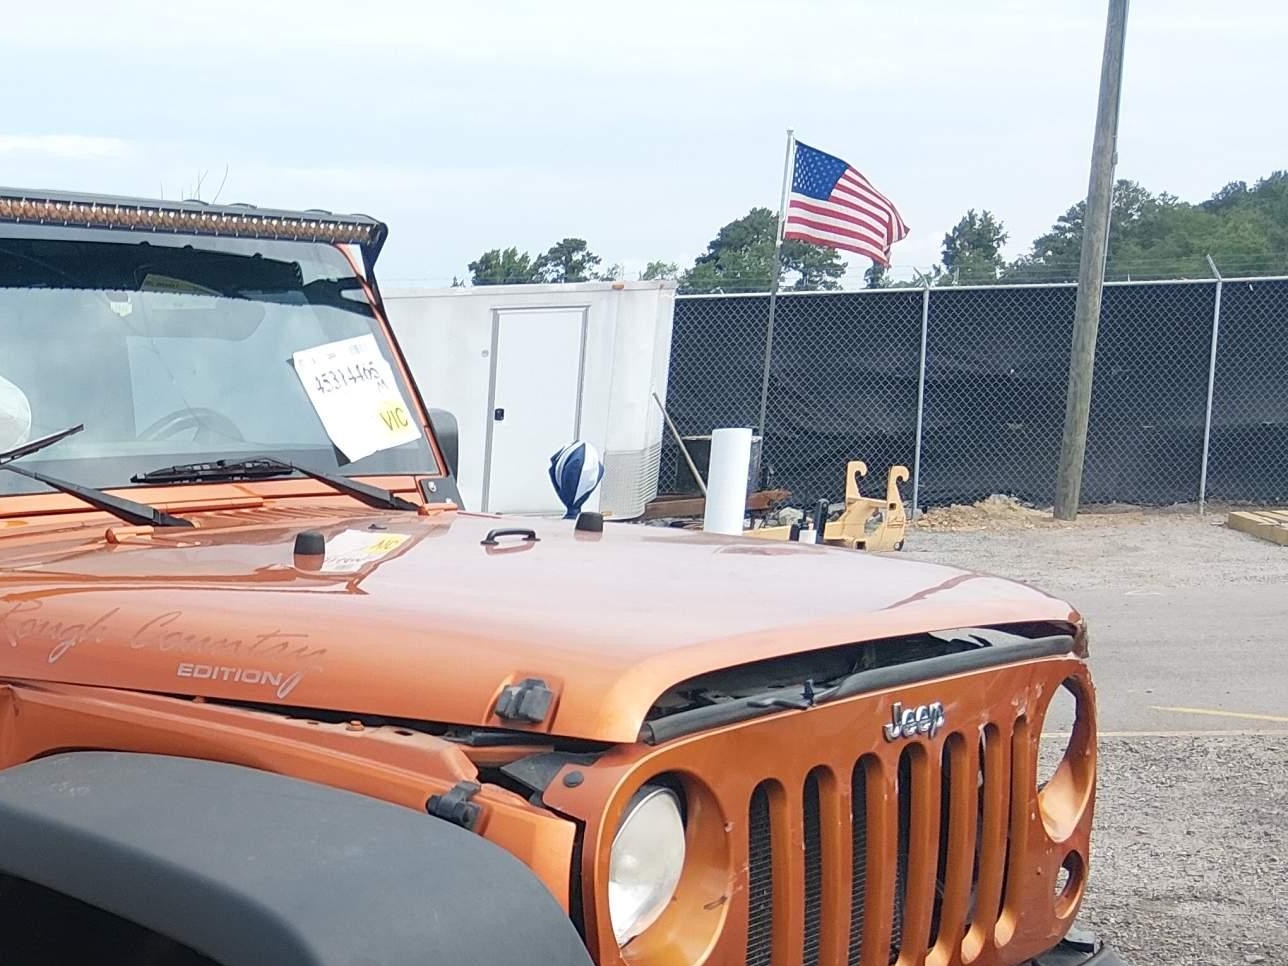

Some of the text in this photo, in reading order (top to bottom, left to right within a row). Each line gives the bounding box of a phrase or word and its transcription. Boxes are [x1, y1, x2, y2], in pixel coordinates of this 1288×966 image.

[379, 407, 409, 432] VIC
[177, 662, 283, 687] EDITION
[882, 701, 944, 742] Jeep
